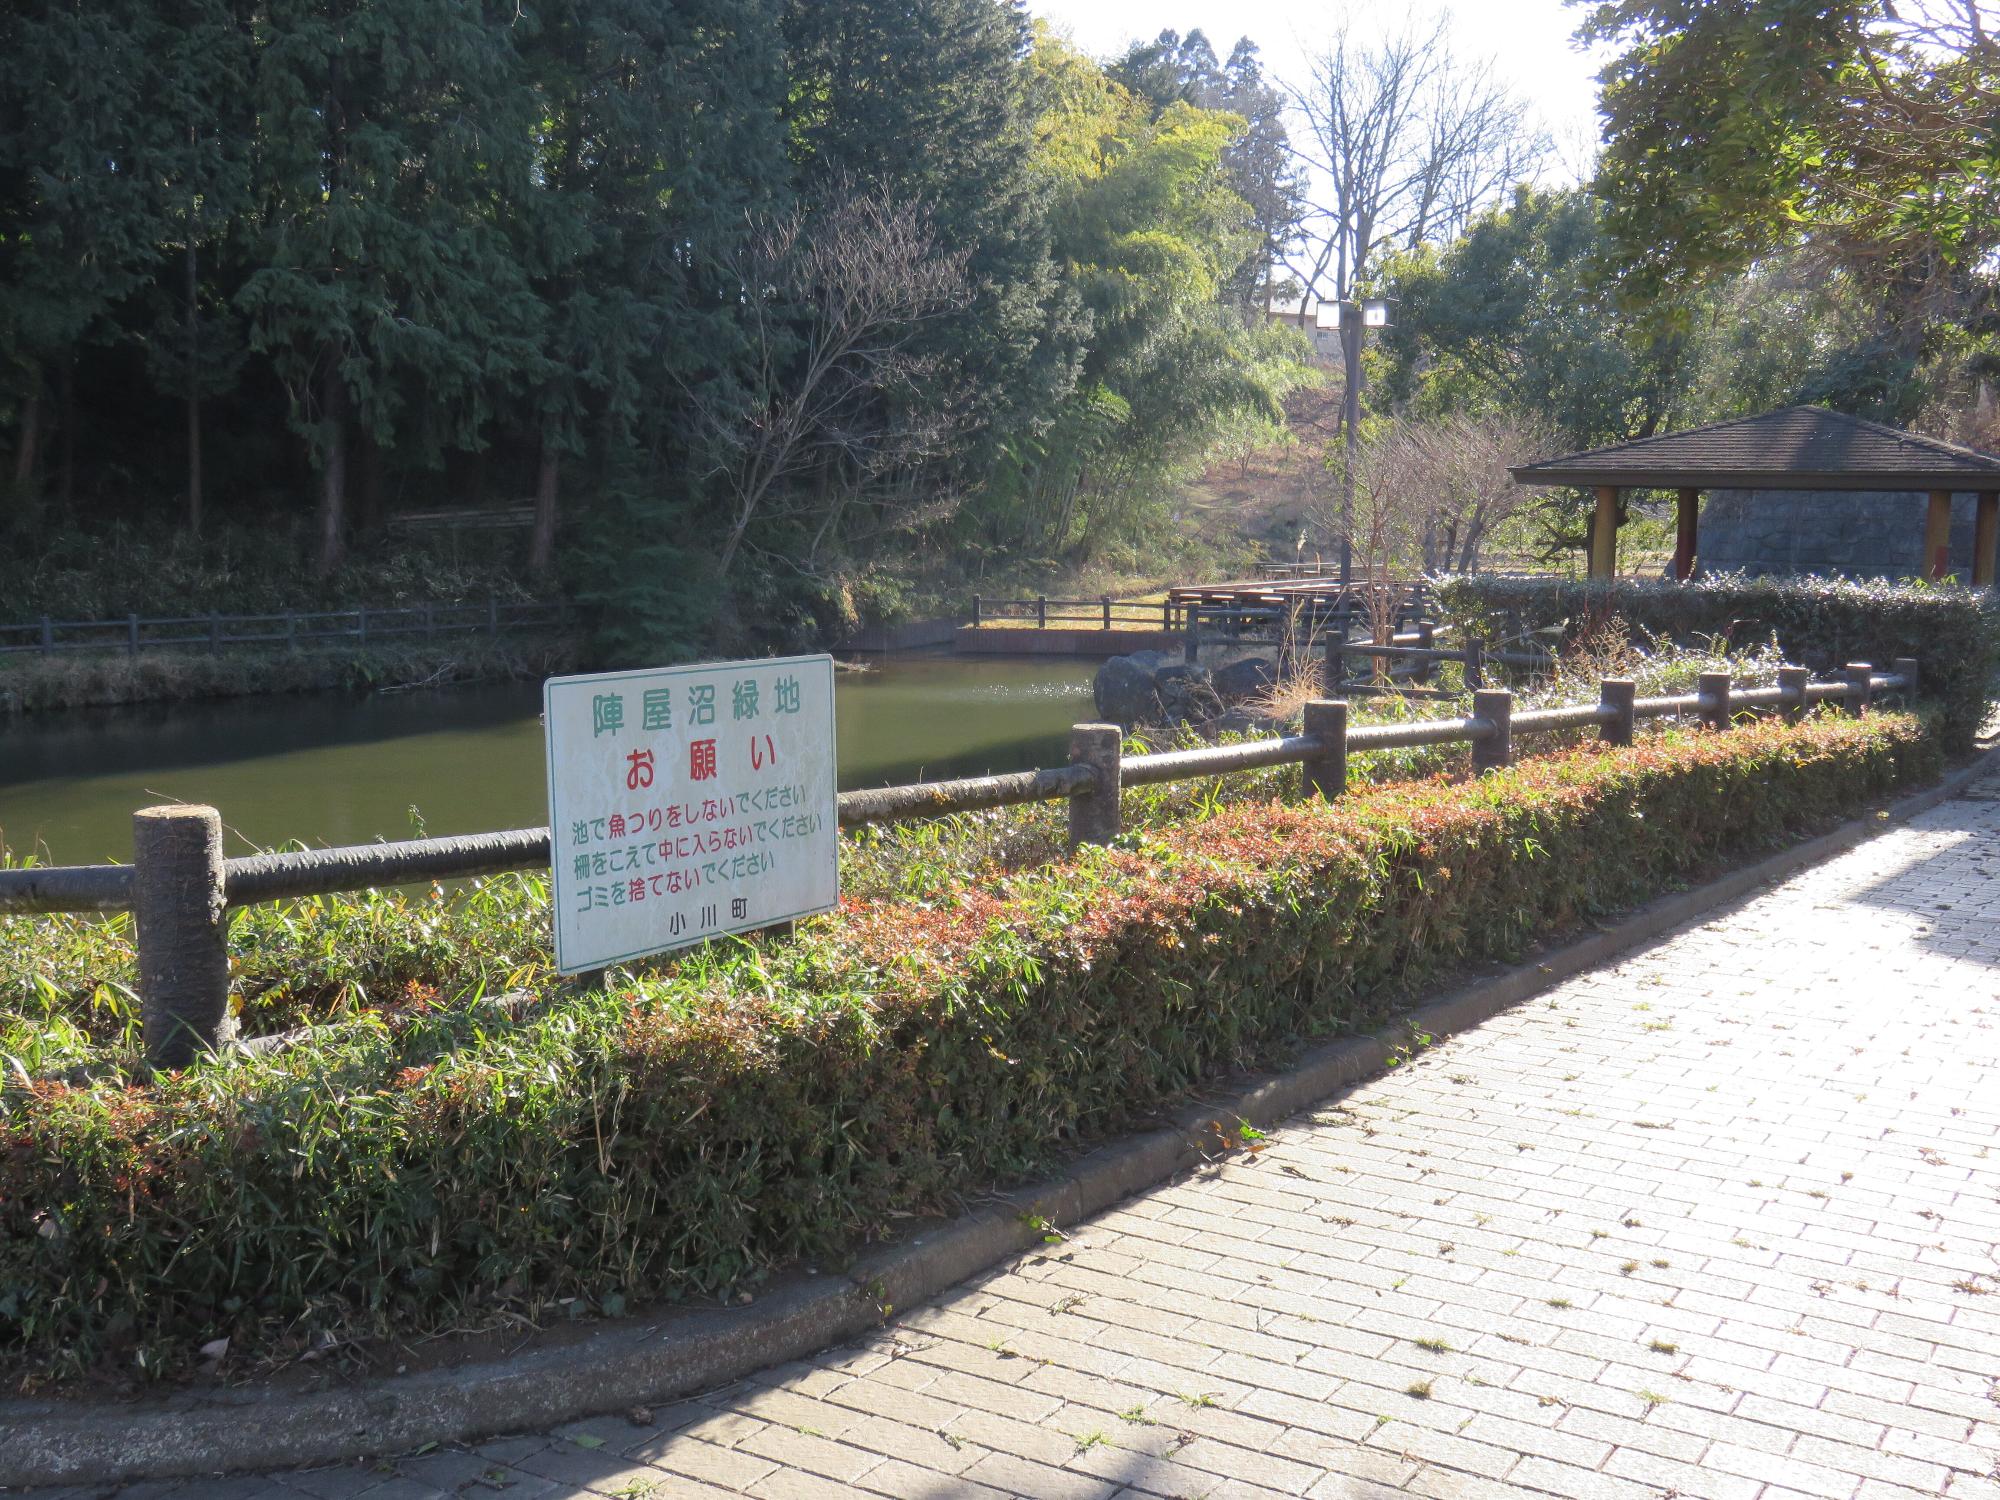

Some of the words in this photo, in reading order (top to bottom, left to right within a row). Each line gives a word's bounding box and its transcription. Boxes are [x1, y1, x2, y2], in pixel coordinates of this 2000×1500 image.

[592, 674, 801, 738] 陣屋沼緑地
[626, 734, 776, 790] お願い
[572, 784, 806, 846] 池で魚つりをしないでください
[574, 813, 822, 881] 柵をこえて中に入らないでください
[577, 850, 774, 912] ゴミを捨てないでください
[669, 897, 748, 936] 小川町
